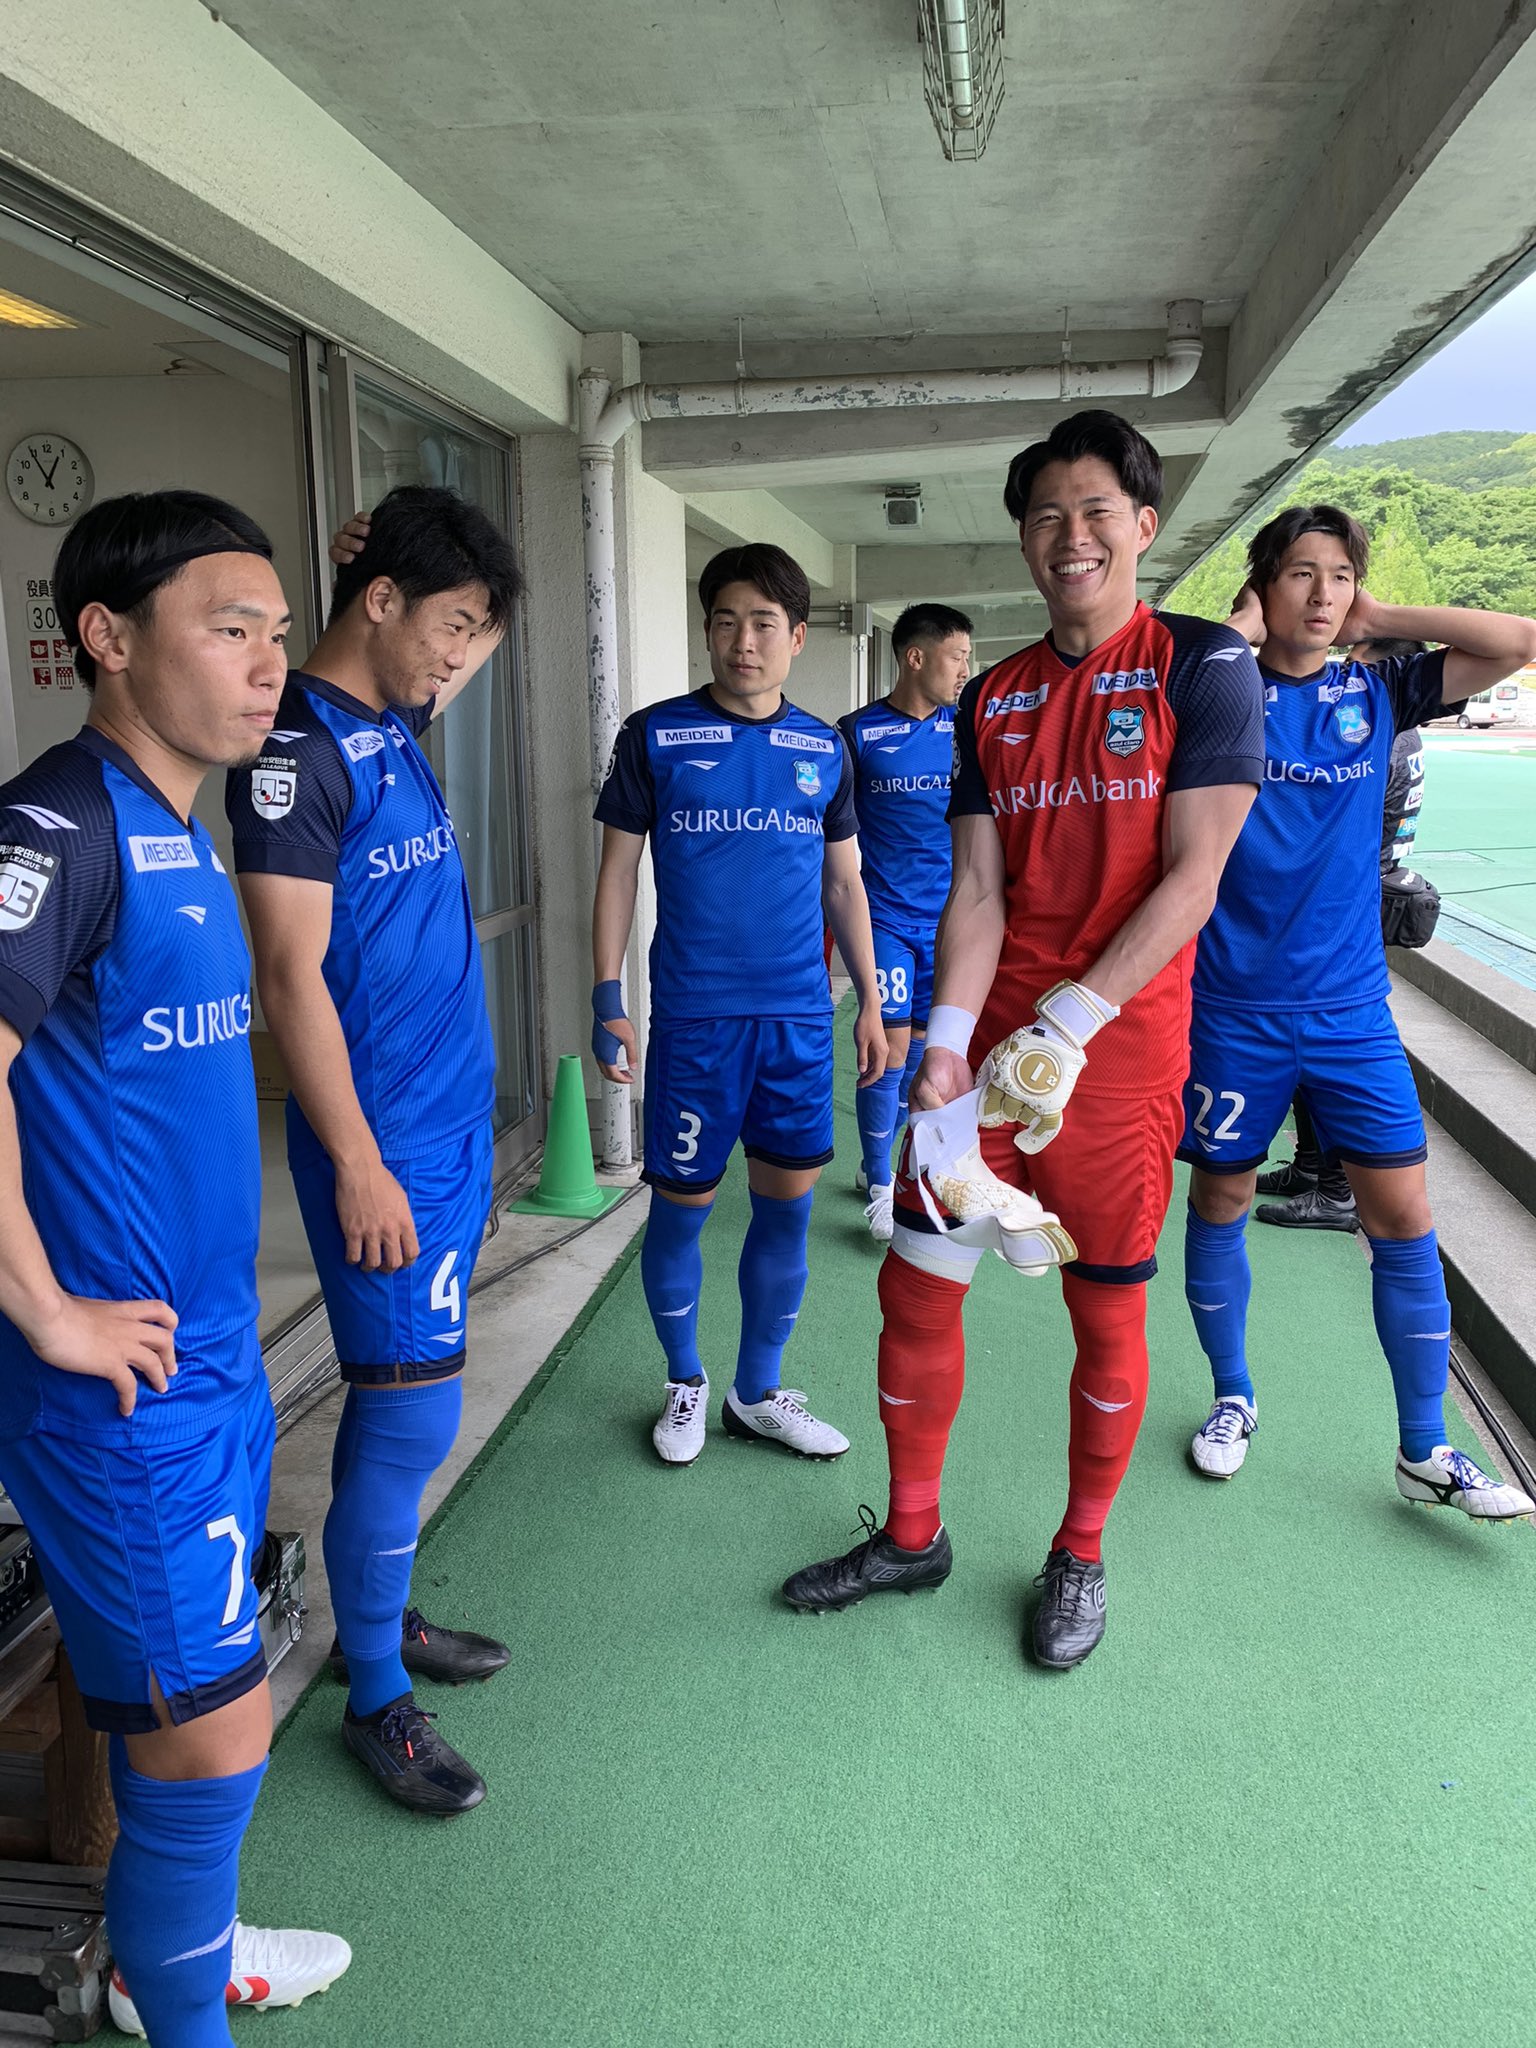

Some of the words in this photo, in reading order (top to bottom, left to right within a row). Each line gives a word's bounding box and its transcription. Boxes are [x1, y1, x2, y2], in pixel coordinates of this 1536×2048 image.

[42, 444, 52, 454] 12
[60, 448, 65, 458] 1
[20, 460, 31, 470] 10
[71, 460, 78, 470] 2
[17, 475, 24, 485] 9
[75, 476, 83, 486] 3
[22, 491, 29, 501] 8
[72, 491, 79, 501] 4
[33, 502, 40, 513] 7
[48, 507, 56, 517] 6
[62, 503, 70, 513] 5
[32, 606, 62, 630] 30
[665, 729, 724, 742] MEIDEN
[777, 732, 828, 750] MEIDEN
[1263, 759, 1332, 784] UGA
[870, 774, 943, 794] SURUGA
[1091, 769, 1161, 804] bank
[670, 808, 783, 834] SURUGA
[140, 841, 194, 864] MEIDEN
[142, 993, 252, 1052] SURUG
[1193, 1082, 1246, 1141] 22
[671, 1110, 703, 1162] 3
[430, 1250, 461, 1324] 4
[206, 1513, 247, 1627] 7
